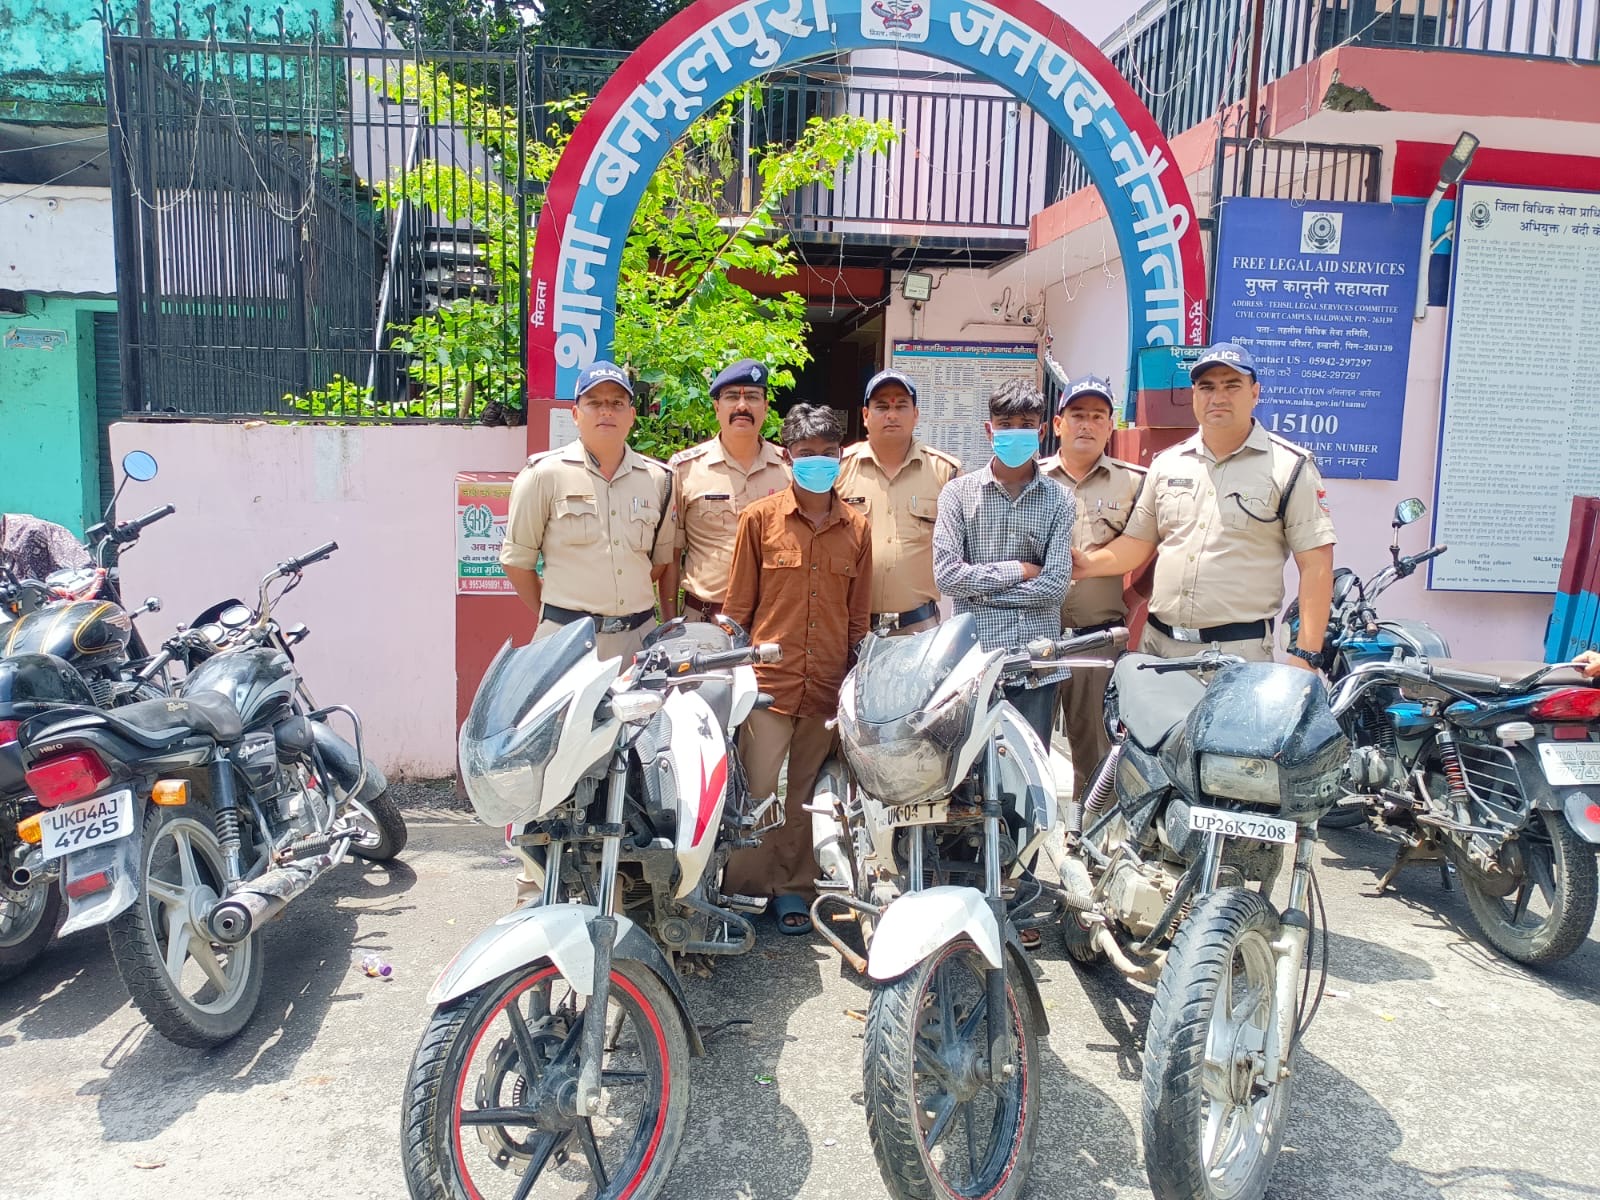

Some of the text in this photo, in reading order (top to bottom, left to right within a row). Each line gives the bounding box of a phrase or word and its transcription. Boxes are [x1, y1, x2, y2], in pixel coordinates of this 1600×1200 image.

[1495, 198, 1600, 217] जिला विधिक सेवा प्राधि
[1520, 219, 1560, 237] अभियुक्त
[1571, 222, 1590, 237] बंदी
[1232, 256, 1405, 276] FREE LEGAL AID SERVICES
[1245, 277, 1389, 299] मुफ्त कानूनी सहायता
[530, 278, 547, 328] मित्रता
[1294, 302, 1318, 310] LEGAL
[1319, 303, 1353, 311] SERVICES
[1354, 305, 1399, 313] COMMITTEE
[1235, 310, 1255, 319] CIVIL
[1256, 311, 1280, 319] COURT
[1202, 350, 1240, 362] POLICE
[1287, 356, 1301, 365] US
[1309, 356, 1372, 367] 05942-297297
[590, 368, 623, 381] POLICE
[1301, 369, 1361, 380] 05942-297297
[1072, 380, 1107, 394] POLICE
[1267, 386, 1324, 395] APPLICATION
[1269, 412, 1339, 435] 15100
[1291, 441, 1378, 453] PLINE NUMBER
[1337, 457, 1368, 467] नम्बर
[51, 799, 118, 831] UK04AJ
[54, 815, 119, 848] 4765
